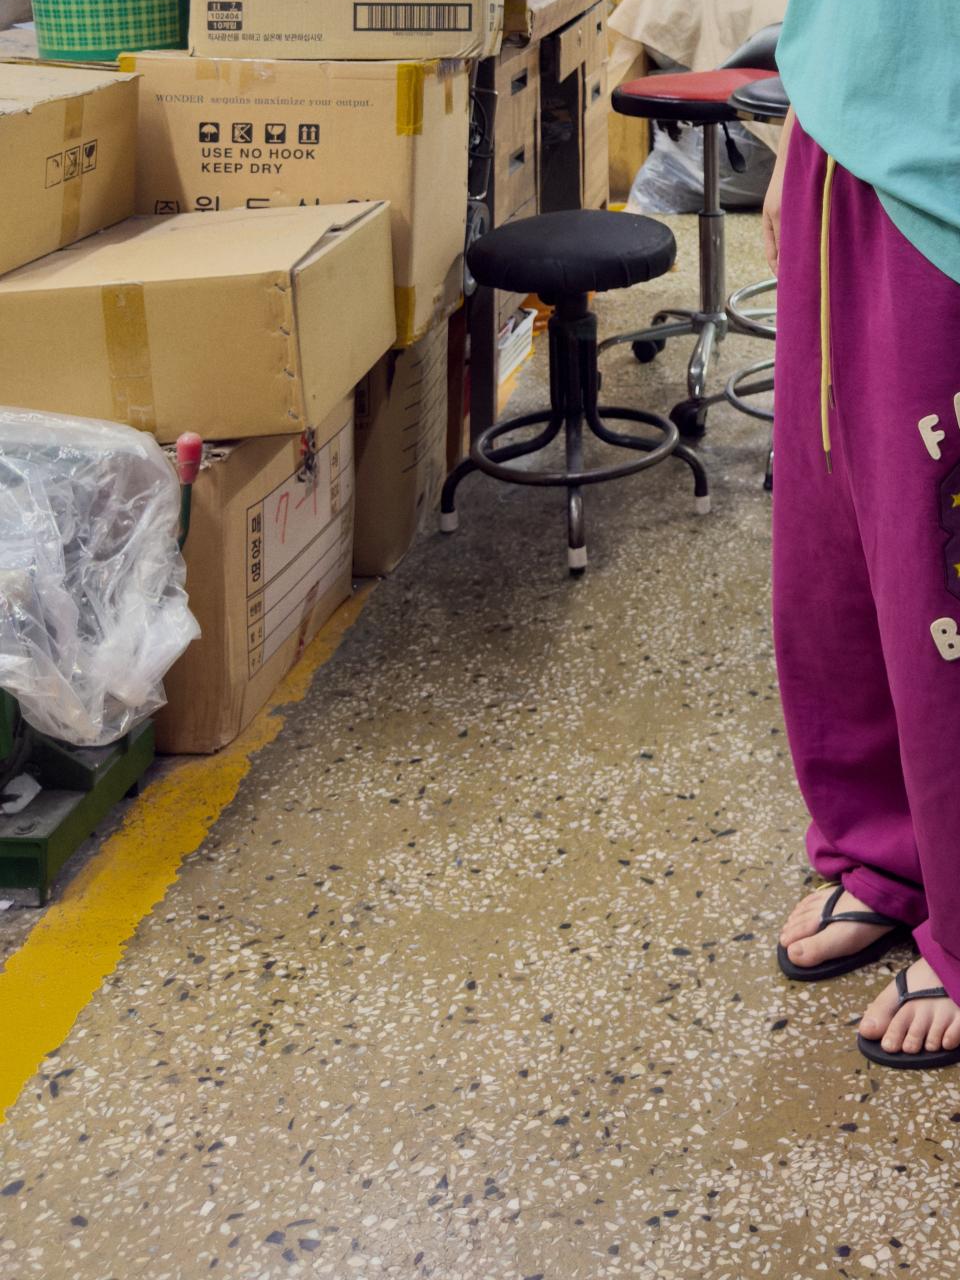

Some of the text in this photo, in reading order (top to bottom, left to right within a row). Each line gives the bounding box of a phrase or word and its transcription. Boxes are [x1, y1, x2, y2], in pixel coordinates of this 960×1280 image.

[155, 94, 374, 108] WONDER sequins maximize your output.
[201, 147, 316, 160] USE NO HOOK
[201, 163, 283, 174] KEEP DRY
